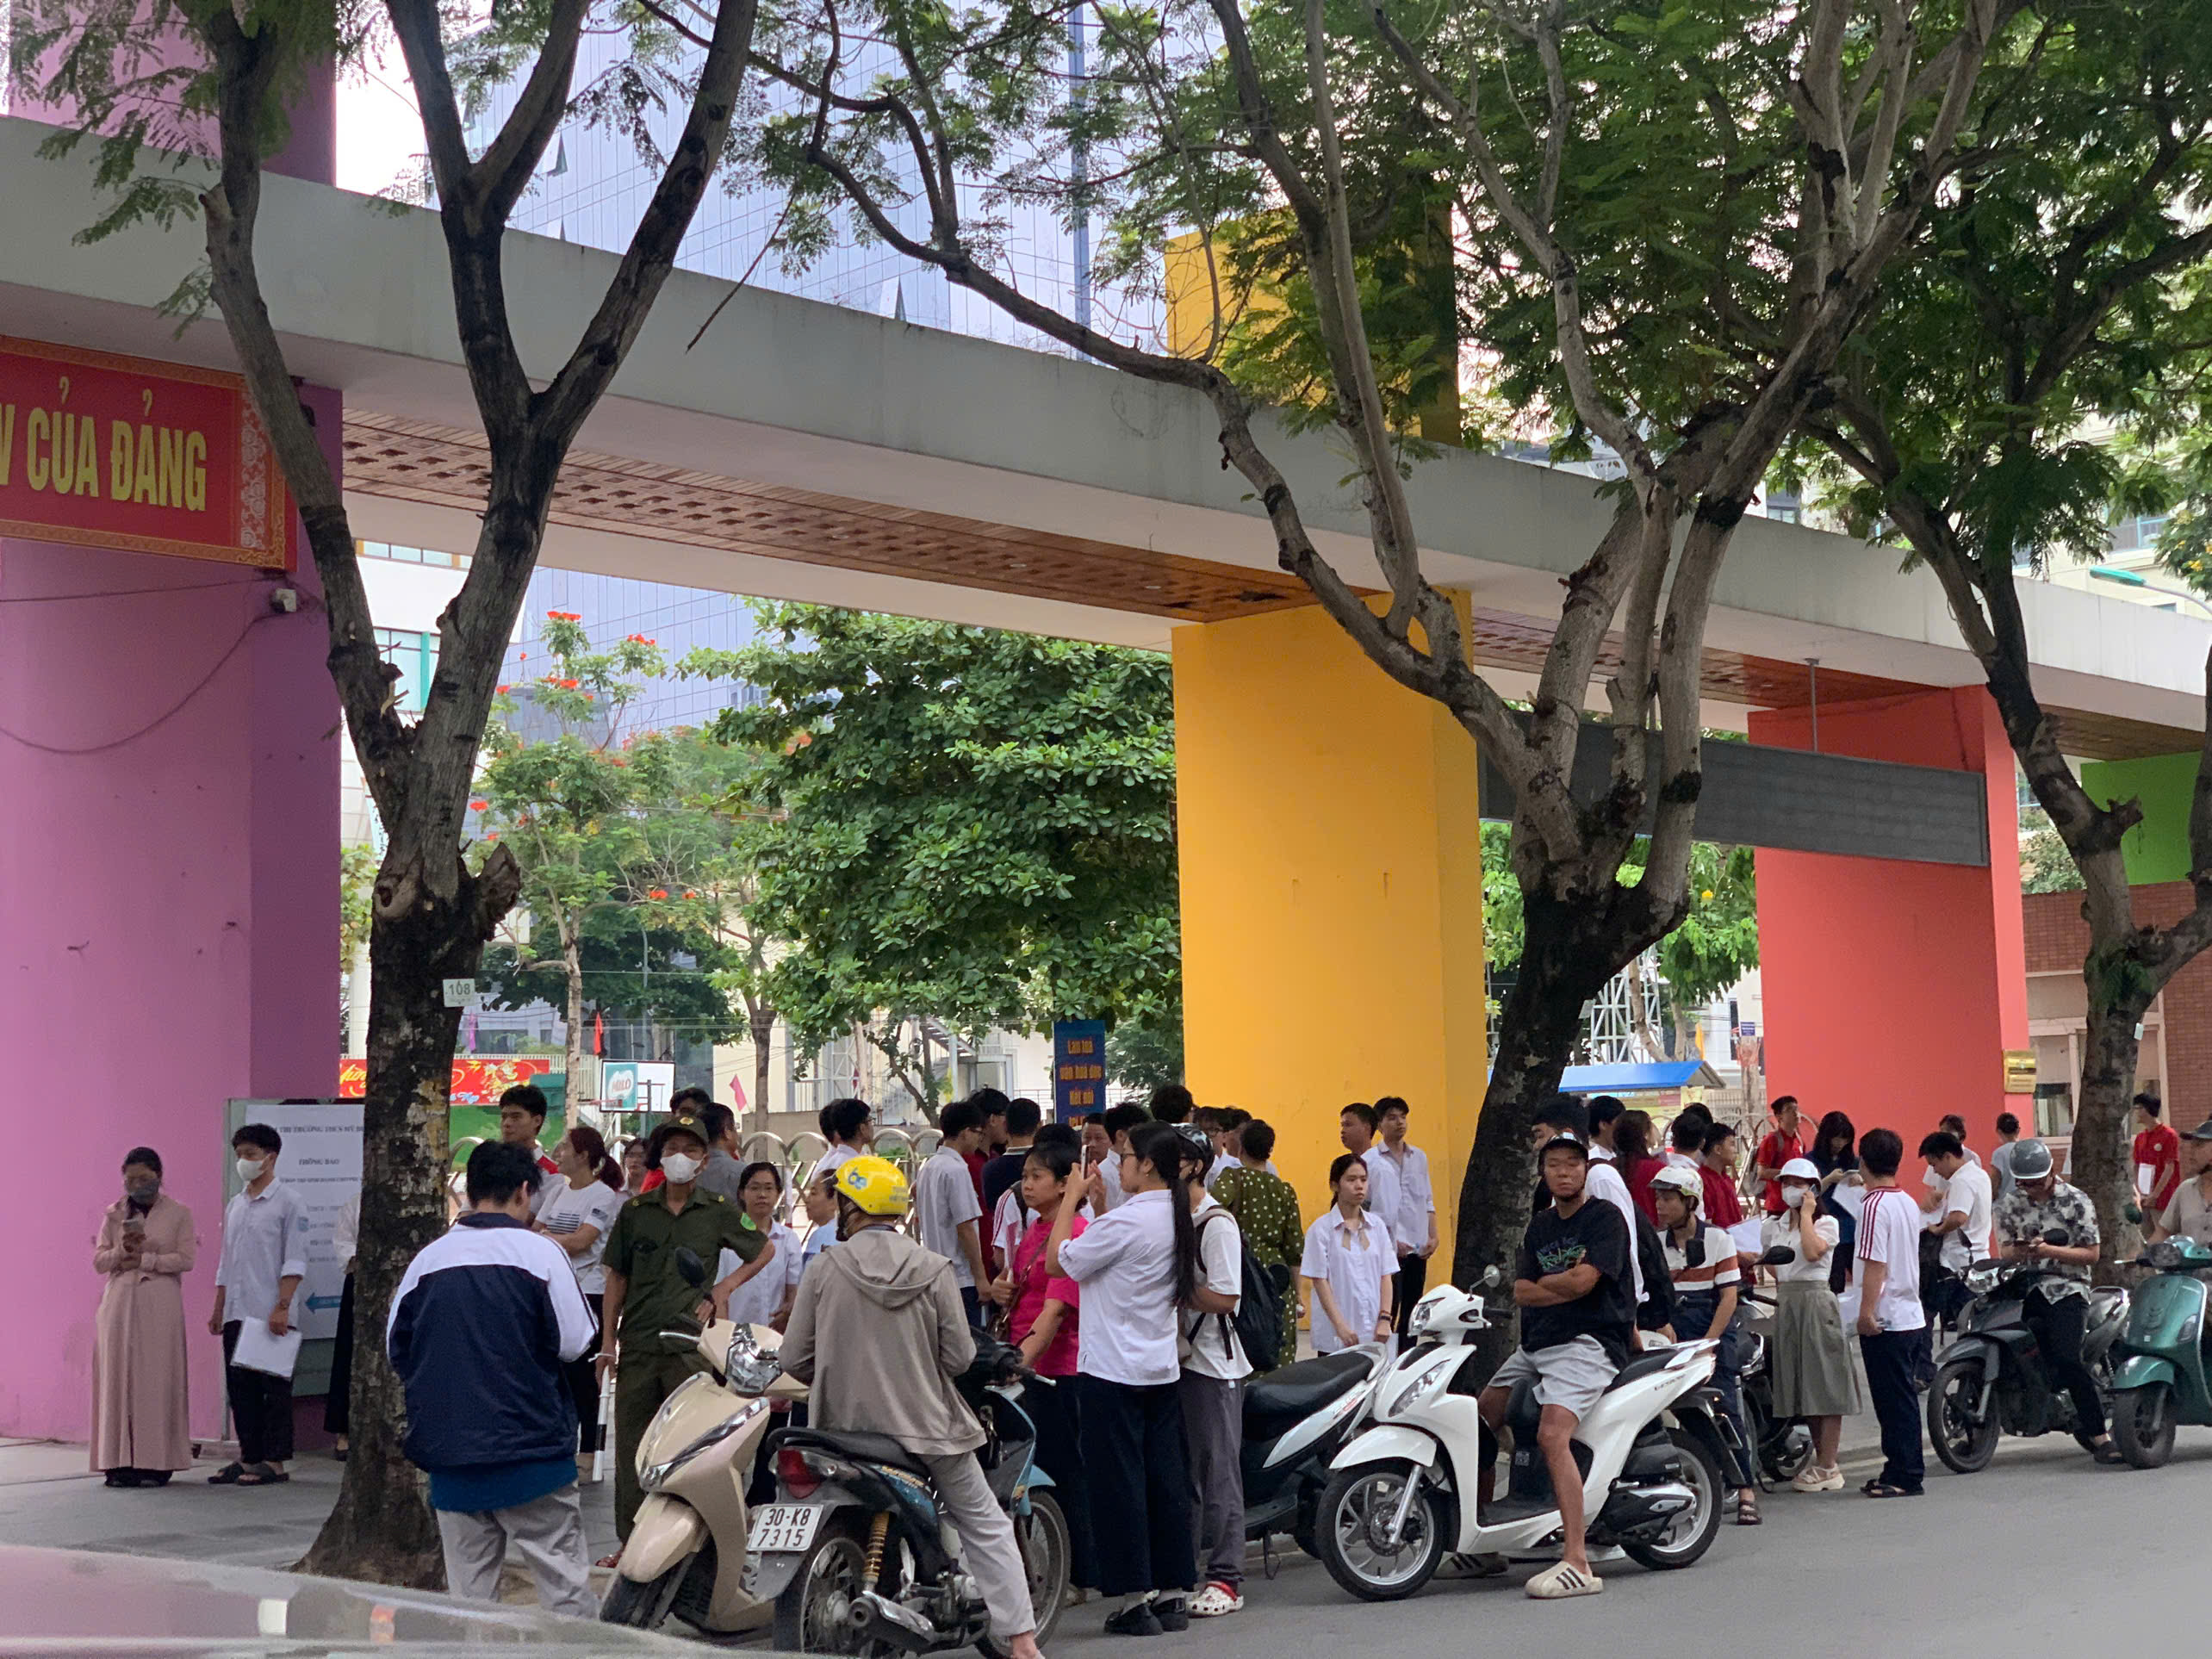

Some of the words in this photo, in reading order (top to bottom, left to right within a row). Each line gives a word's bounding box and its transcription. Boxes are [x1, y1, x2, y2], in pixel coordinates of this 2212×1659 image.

[27, 376, 99, 498] CỦA
[110, 388, 207, 512] ĐẢNG
[448, 983, 470, 996] 108
[765, 1507, 811, 1526] 30-K8
[757, 1528, 805, 1547] 7315
